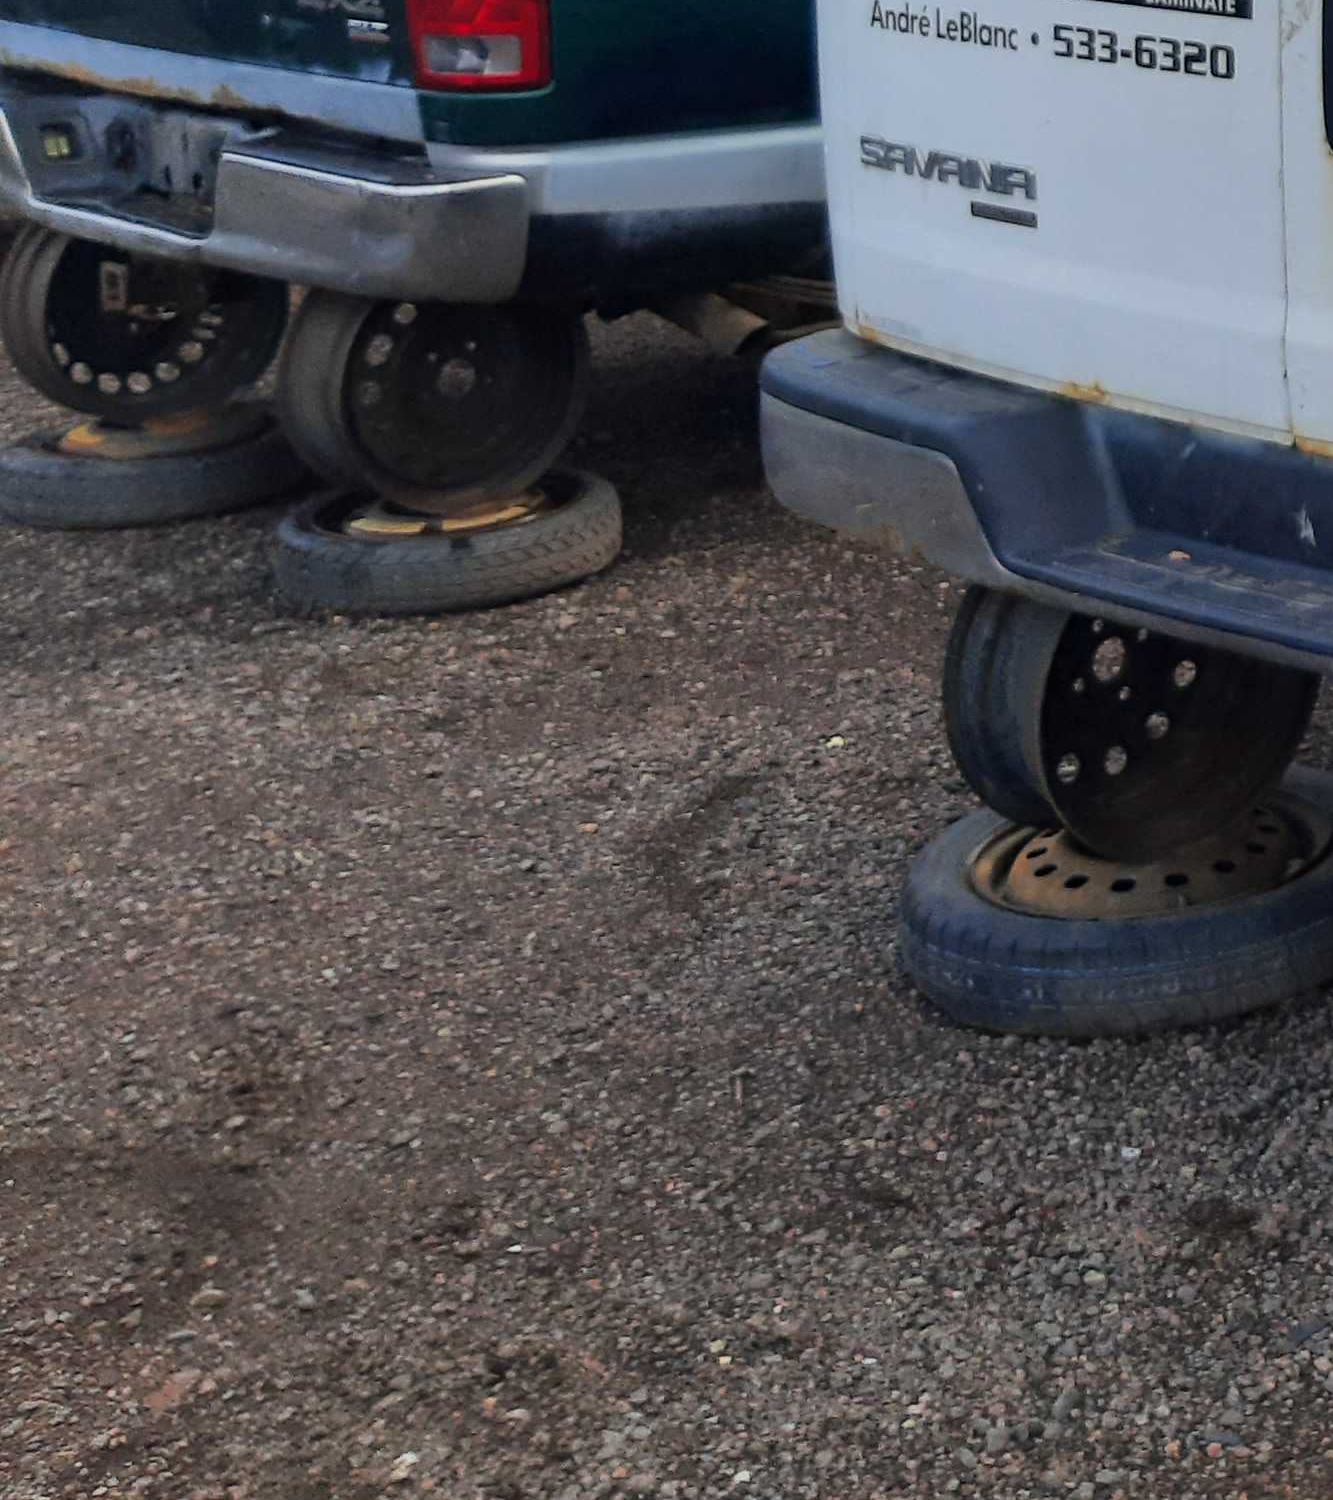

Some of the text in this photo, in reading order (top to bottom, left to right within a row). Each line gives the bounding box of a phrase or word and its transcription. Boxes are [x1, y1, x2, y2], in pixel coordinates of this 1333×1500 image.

[936, 6, 1019, 51] LeBlanc
[1052, 22, 1237, 80] 533-6320
[860, 135, 1038, 201] SAVANA
